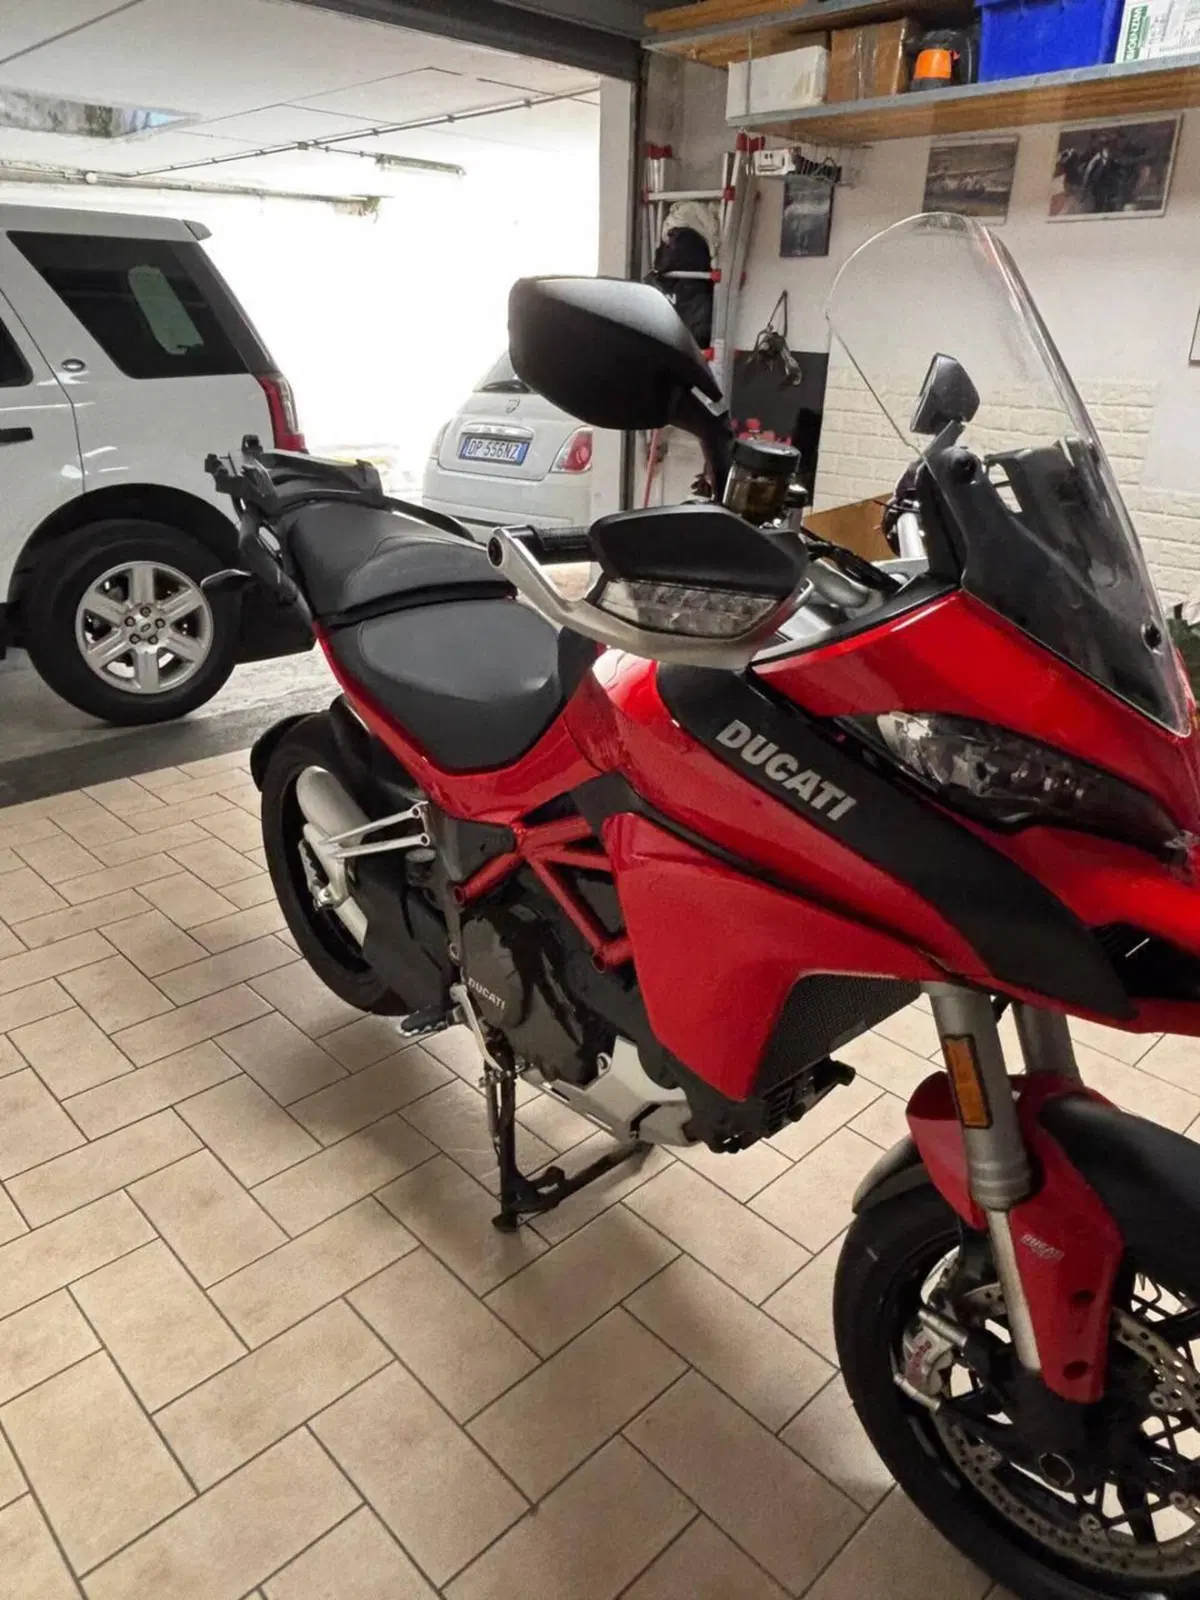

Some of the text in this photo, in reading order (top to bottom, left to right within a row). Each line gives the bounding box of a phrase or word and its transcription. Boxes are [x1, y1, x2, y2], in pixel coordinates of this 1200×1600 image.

[468, 439, 519, 460] DP 556NZ
[715, 719, 857, 821] DUCATI
[468, 977, 505, 1010] DUCATI
